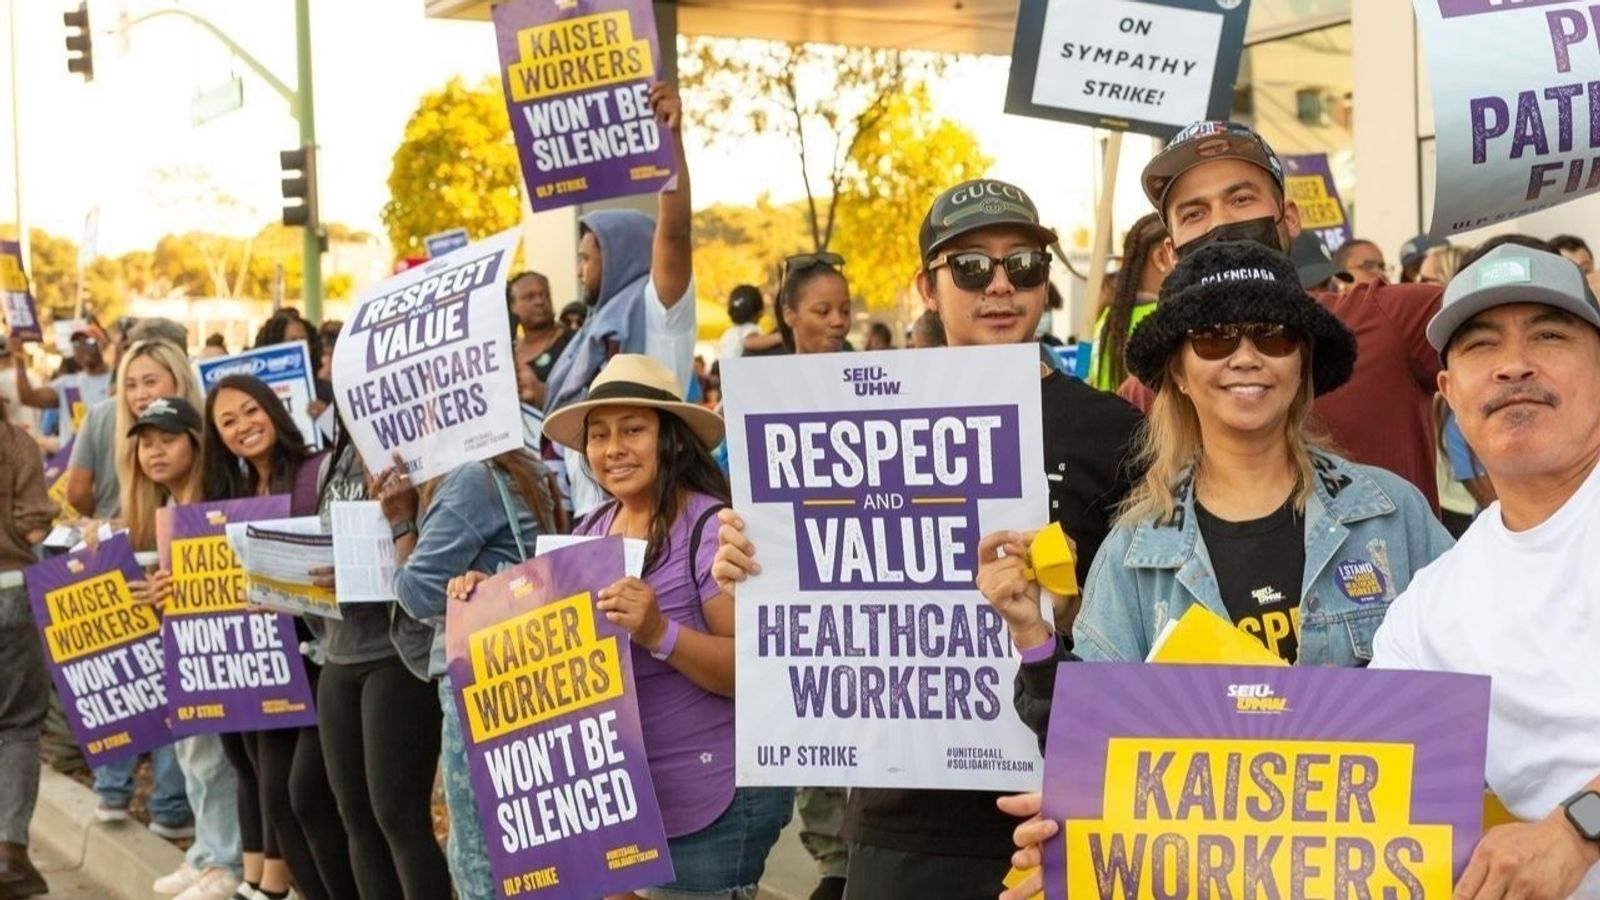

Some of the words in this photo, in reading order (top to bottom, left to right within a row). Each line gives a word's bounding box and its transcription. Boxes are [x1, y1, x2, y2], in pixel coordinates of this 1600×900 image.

[530, 18, 620, 60] KAISER
[1119, 17, 1152, 36] ON
[518, 46, 643, 95] WORKERS
[1060, 42, 1197, 77] SYMPATHY
[523, 91, 610, 138] WON'T
[614, 83, 654, 121] BE
[1082, 79, 1165, 106] STRIKE!
[532, 118, 660, 172] SILENCED
[951, 182, 1025, 205] GUCCI
[361, 255, 496, 328] RESPECT
[408, 303, 433, 319] AND
[372, 301, 465, 366] VALUE
[347, 340, 500, 421] HEALTHCARE
[843, 367, 888, 383] SEIU-
[853, 380, 901, 397] UHW
[371, 382, 488, 451] WORKERS
[763, 415, 1002, 489] RESPECT
[863, 493, 904, 510] AND
[182, 542, 241, 574] KAIS
[803, 516, 973, 584] VALUE
[55, 578, 123, 622] KAISER
[172, 574, 246, 610] WORKE
[52, 605, 149, 655] WORKERS
[172, 615, 244, 655] WON'T
[249, 613, 283, 650] BE
[482, 604, 583, 679] KAISER
[757, 604, 1013, 657] HEALTHCAR
[62, 647, 135, 697] WON'T
[178, 651, 291, 693] SILENCED
[472, 649, 611, 733] WORKERS
[788, 665, 1001, 721] WORKERS
[75, 674, 168, 730] SILENCE
[484, 723, 576, 799] WON'T
[579, 709, 624, 771] BE
[757, 746, 790, 767] ULP
[797, 746, 858, 767] STRIKE
[947, 747, 1002, 759] #UNITED4ALL
[947, 758, 1034, 772] #SOLIDARITYSEASON
[497, 767, 638, 854] SILENCED
[1133, 750, 1379, 823] KAISER
[503, 875, 523, 897] ULP
[524, 867, 560, 891] STRIKE
[1089, 832, 1426, 900] WORKERS
